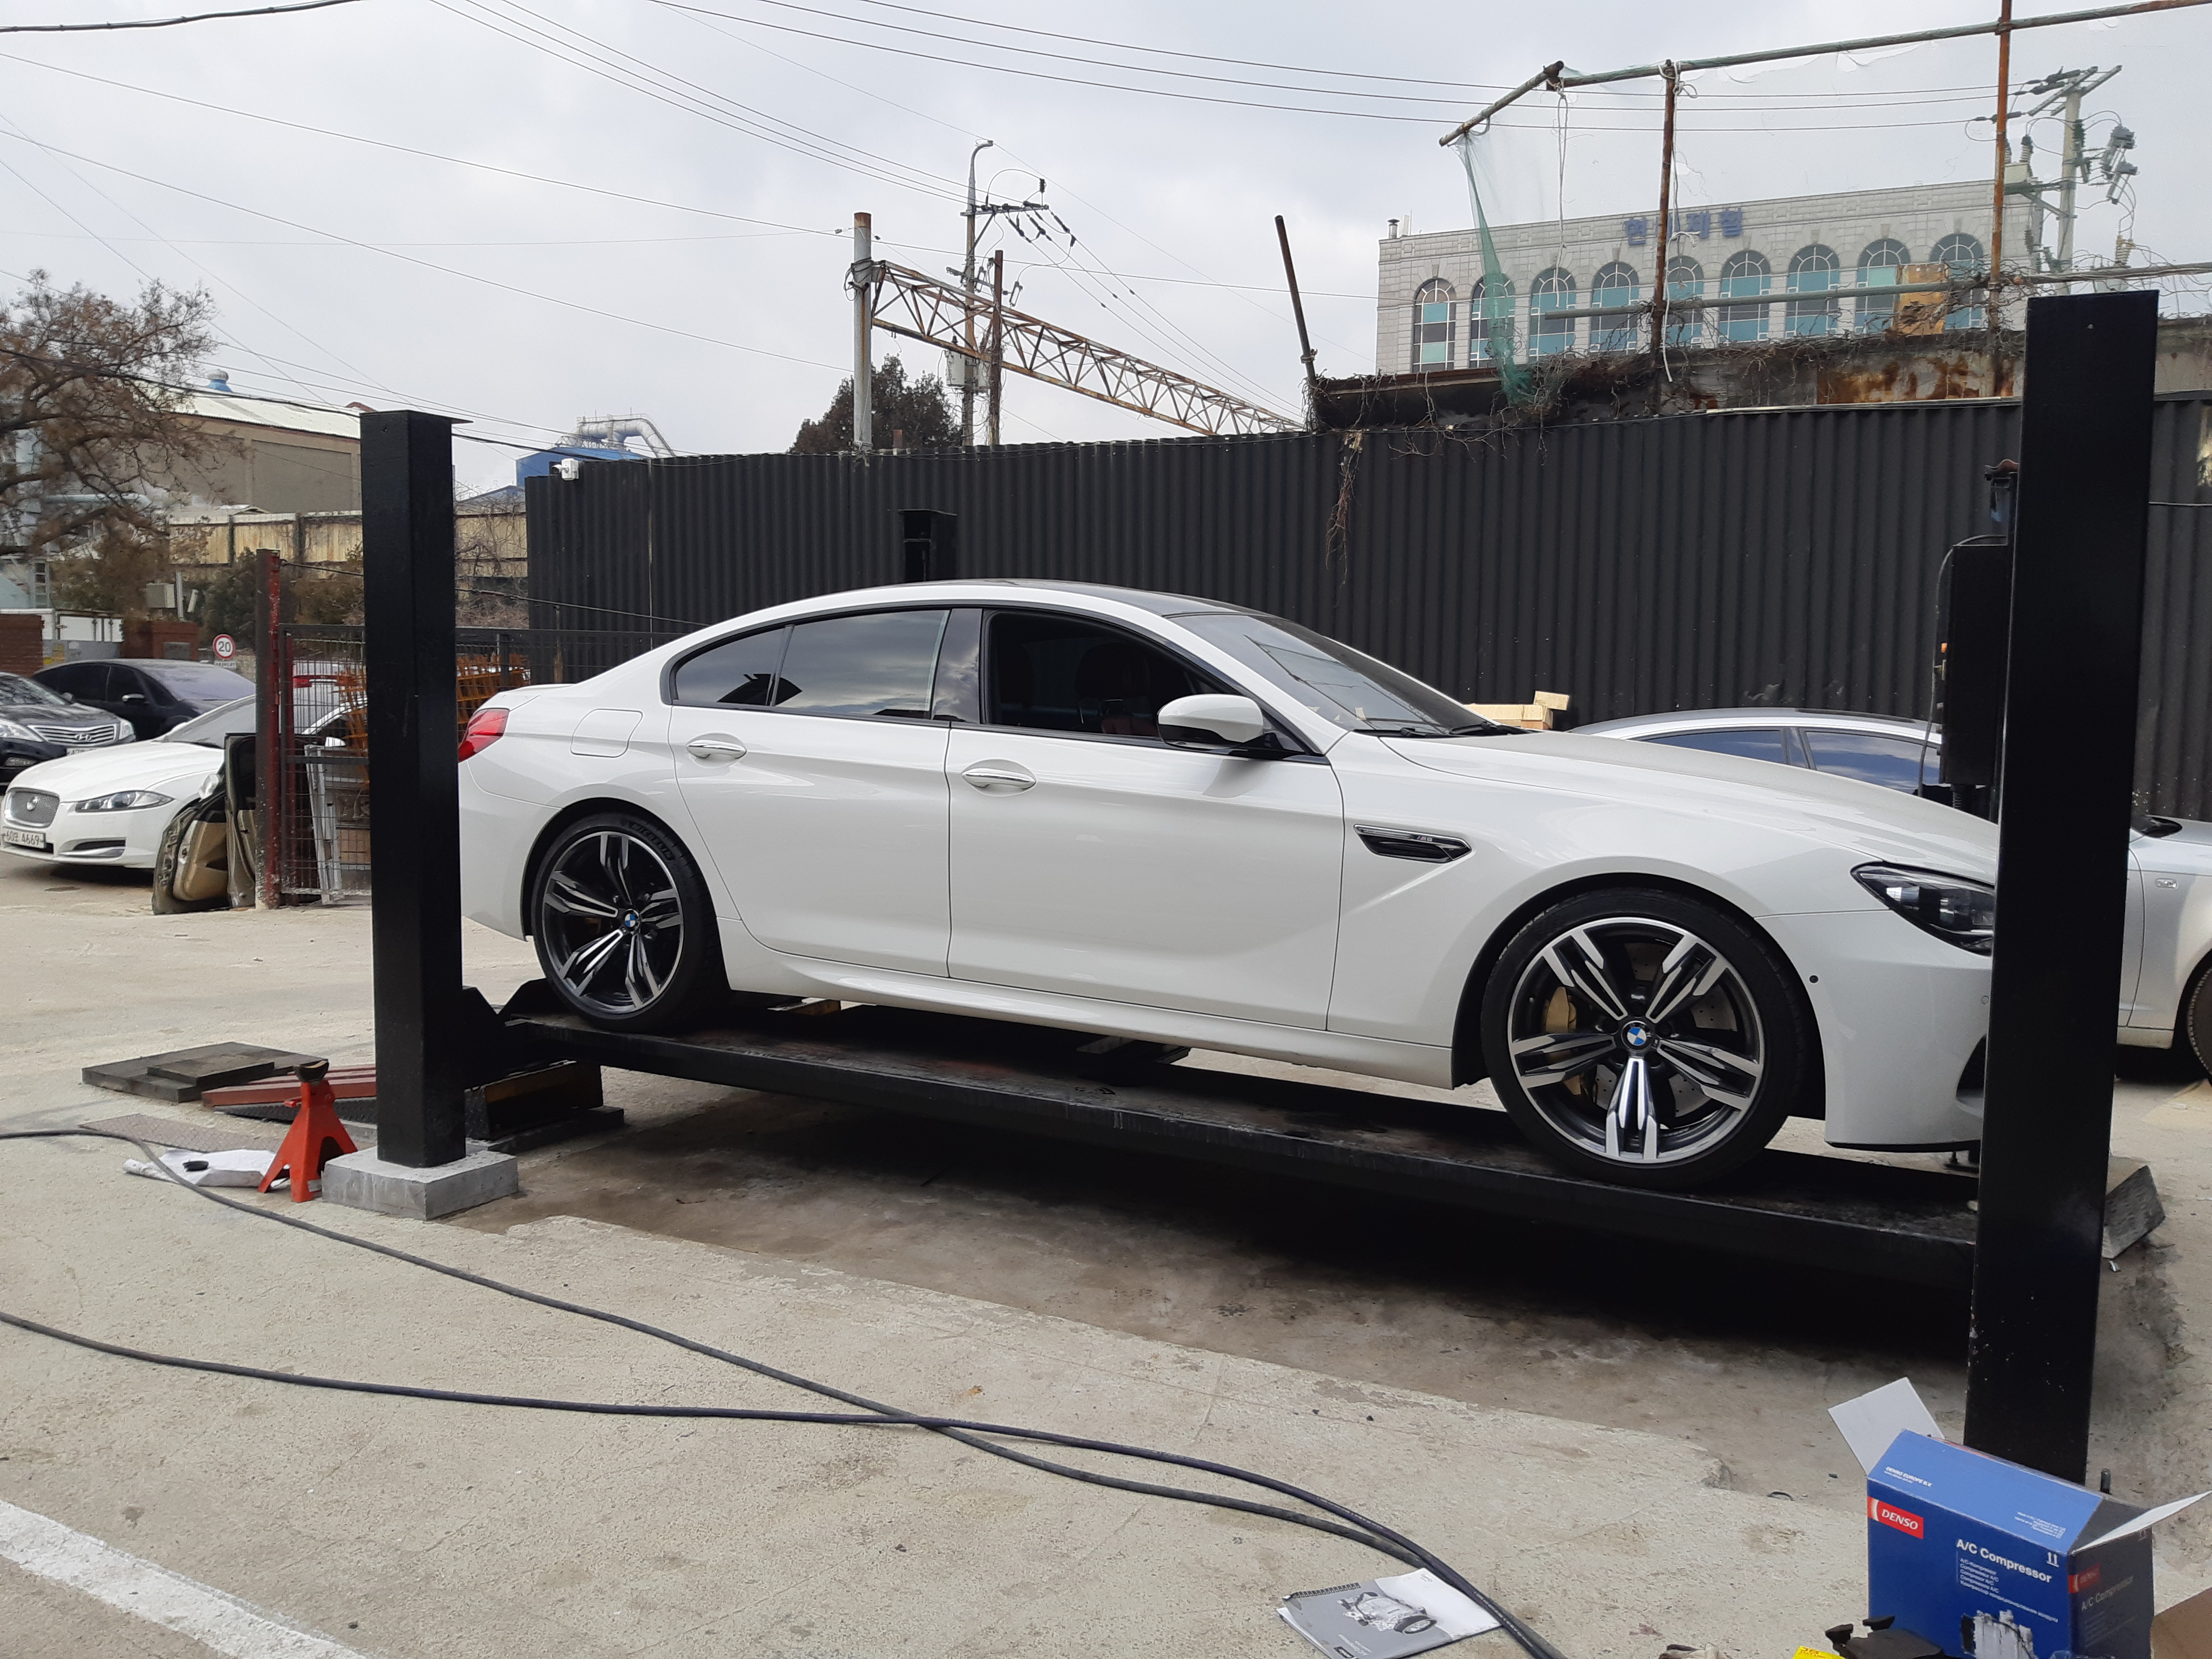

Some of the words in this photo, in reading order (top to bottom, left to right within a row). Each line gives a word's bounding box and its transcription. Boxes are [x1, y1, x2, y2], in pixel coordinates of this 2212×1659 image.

[218, 641, 231, 652] 20
[22, 833, 39, 845] 4669
[1885, 1467, 1903, 1476] DENSO
[1902, 1473, 1923, 1484] EUROPE
[1881, 1508, 1919, 1530] DENSO
[1956, 1539, 1978, 1554] A/C
[1980, 1547, 2052, 1583] Compressor
